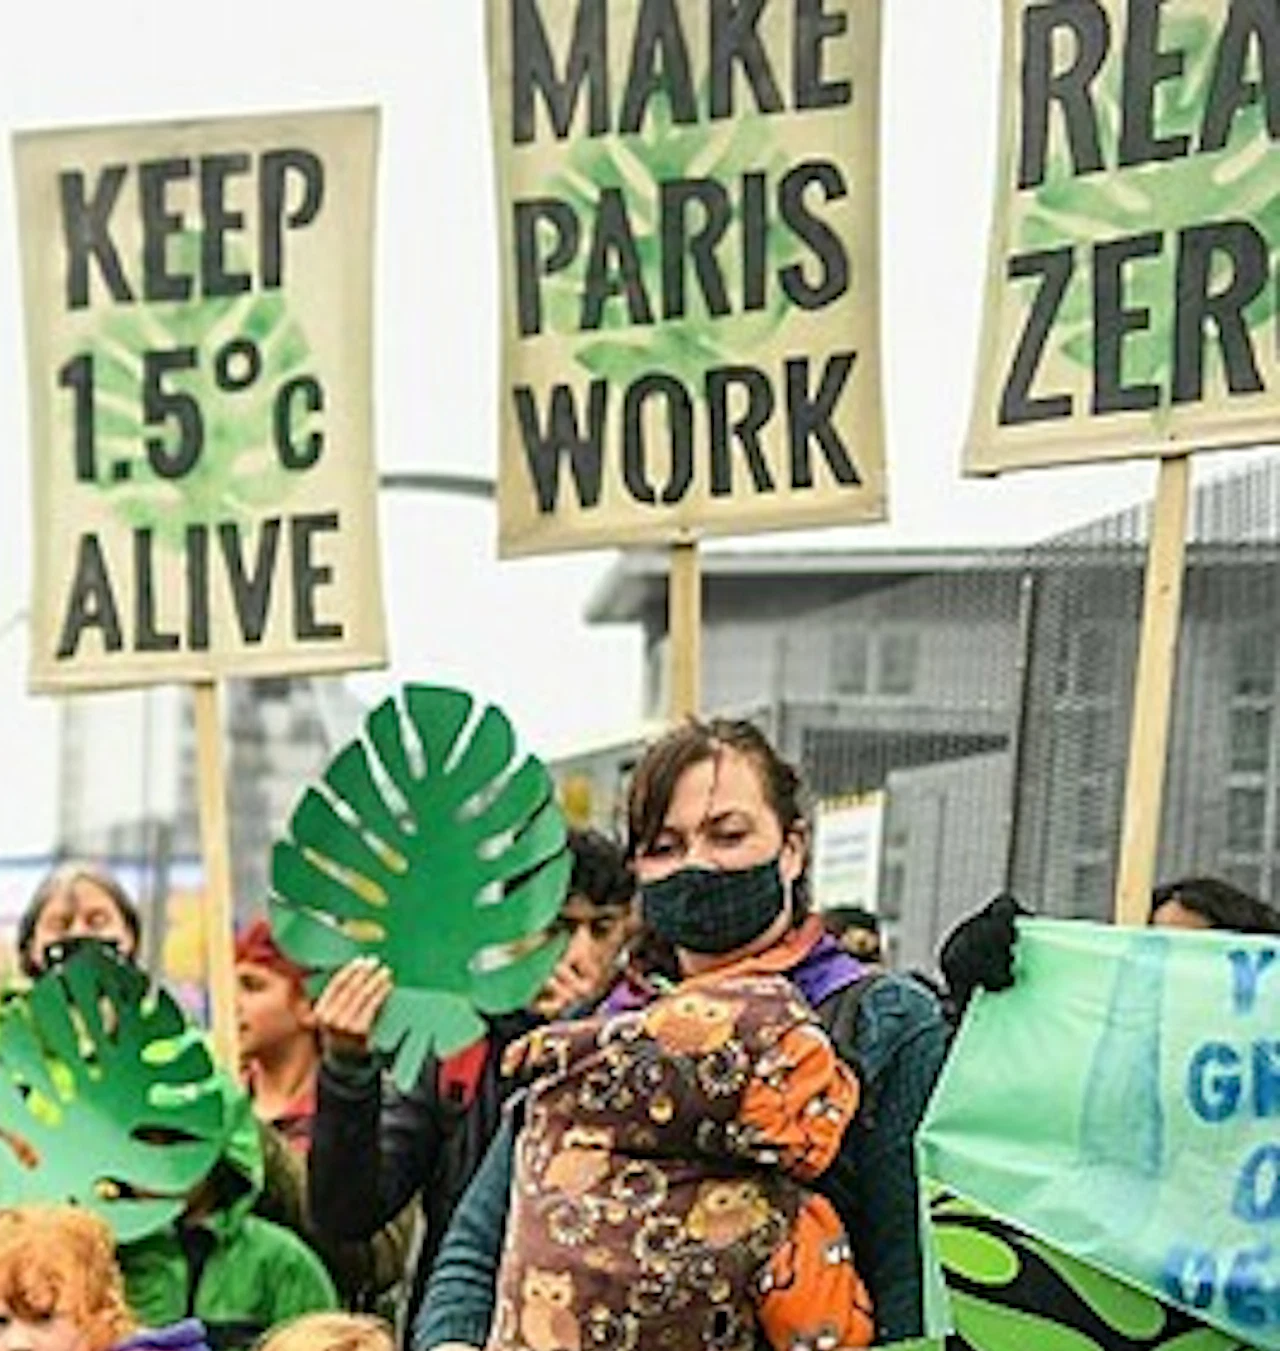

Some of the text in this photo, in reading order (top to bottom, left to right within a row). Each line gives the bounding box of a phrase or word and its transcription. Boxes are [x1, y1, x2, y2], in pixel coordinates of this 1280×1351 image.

[512, 0, 853, 144] MAKE
[1017, 0, 1280, 190] REA
[57, 148, 326, 310] KEEP
[512, 160, 851, 339] PARIS
[998, 220, 1280, 426] ZER
[513, 351, 863, 515] WORK
[56, 511, 344, 660] ALIVE
